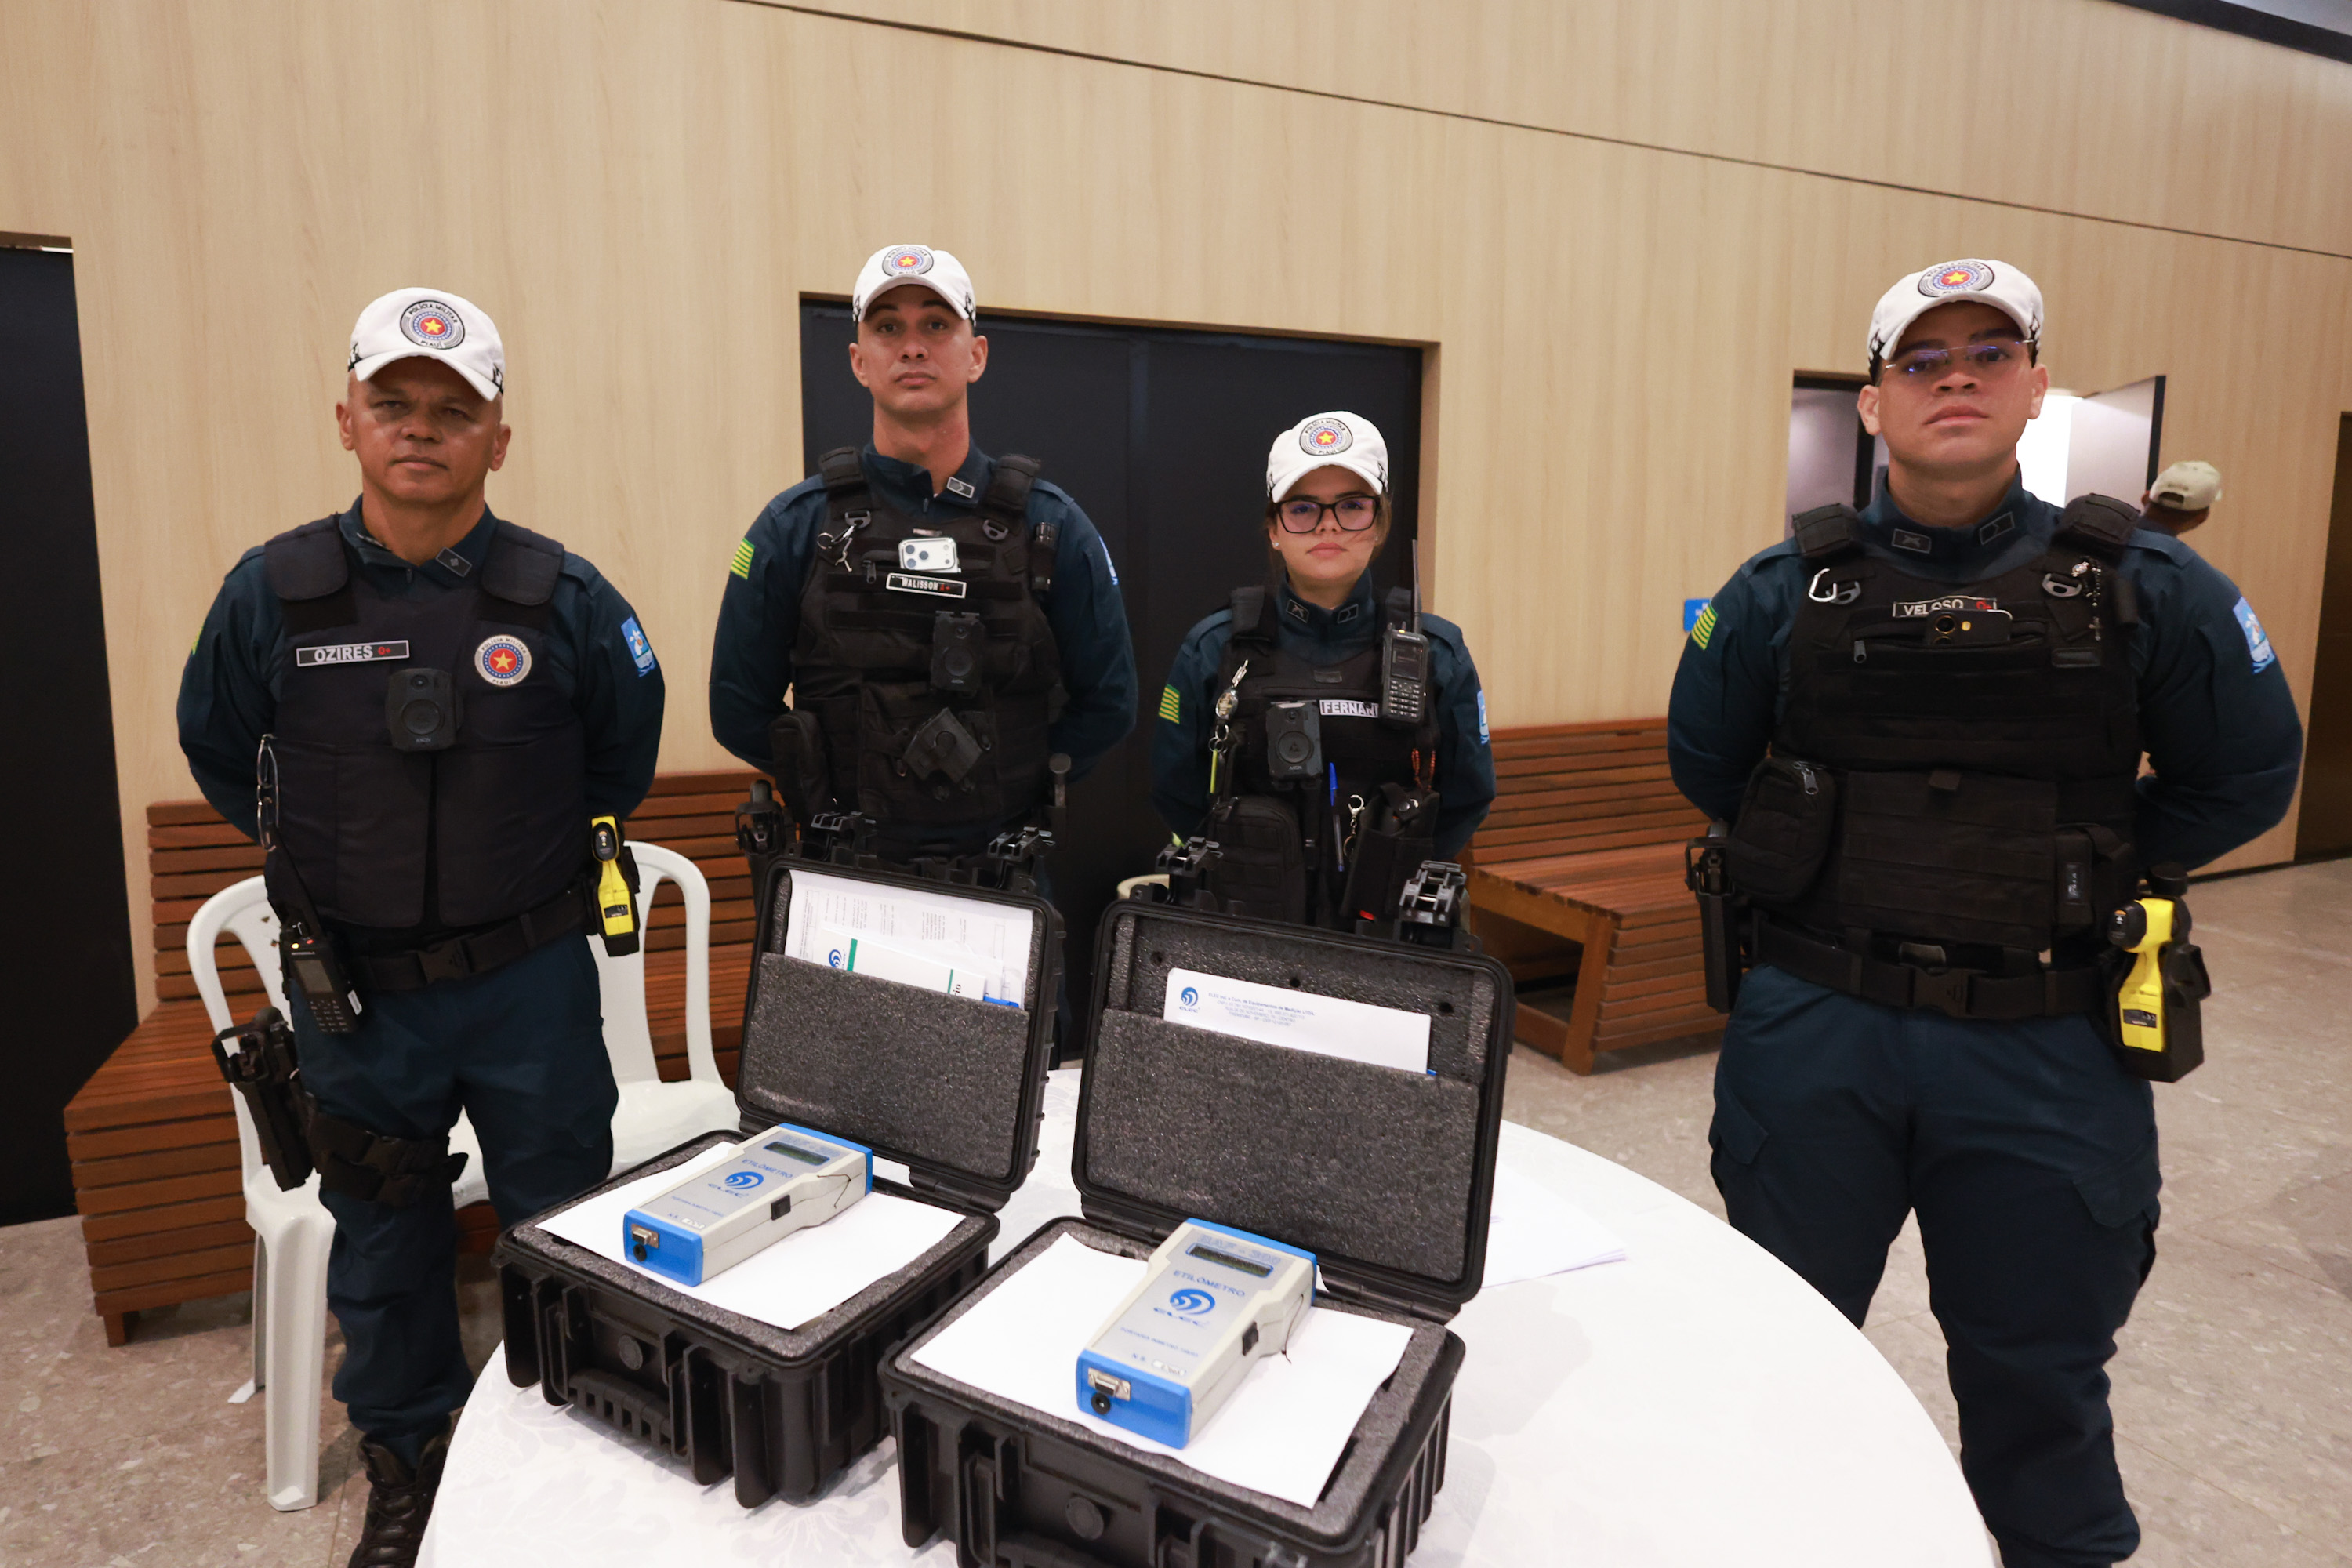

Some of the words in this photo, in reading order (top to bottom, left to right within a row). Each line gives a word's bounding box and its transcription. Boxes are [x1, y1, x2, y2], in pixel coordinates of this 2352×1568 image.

[435, 304, 458, 323] MILITAR
[902, 578, 938, 590] WALISSON
[314, 645, 373, 662] OZIRES
[1173, 1269, 1246, 1298] ETILÔMETRO
